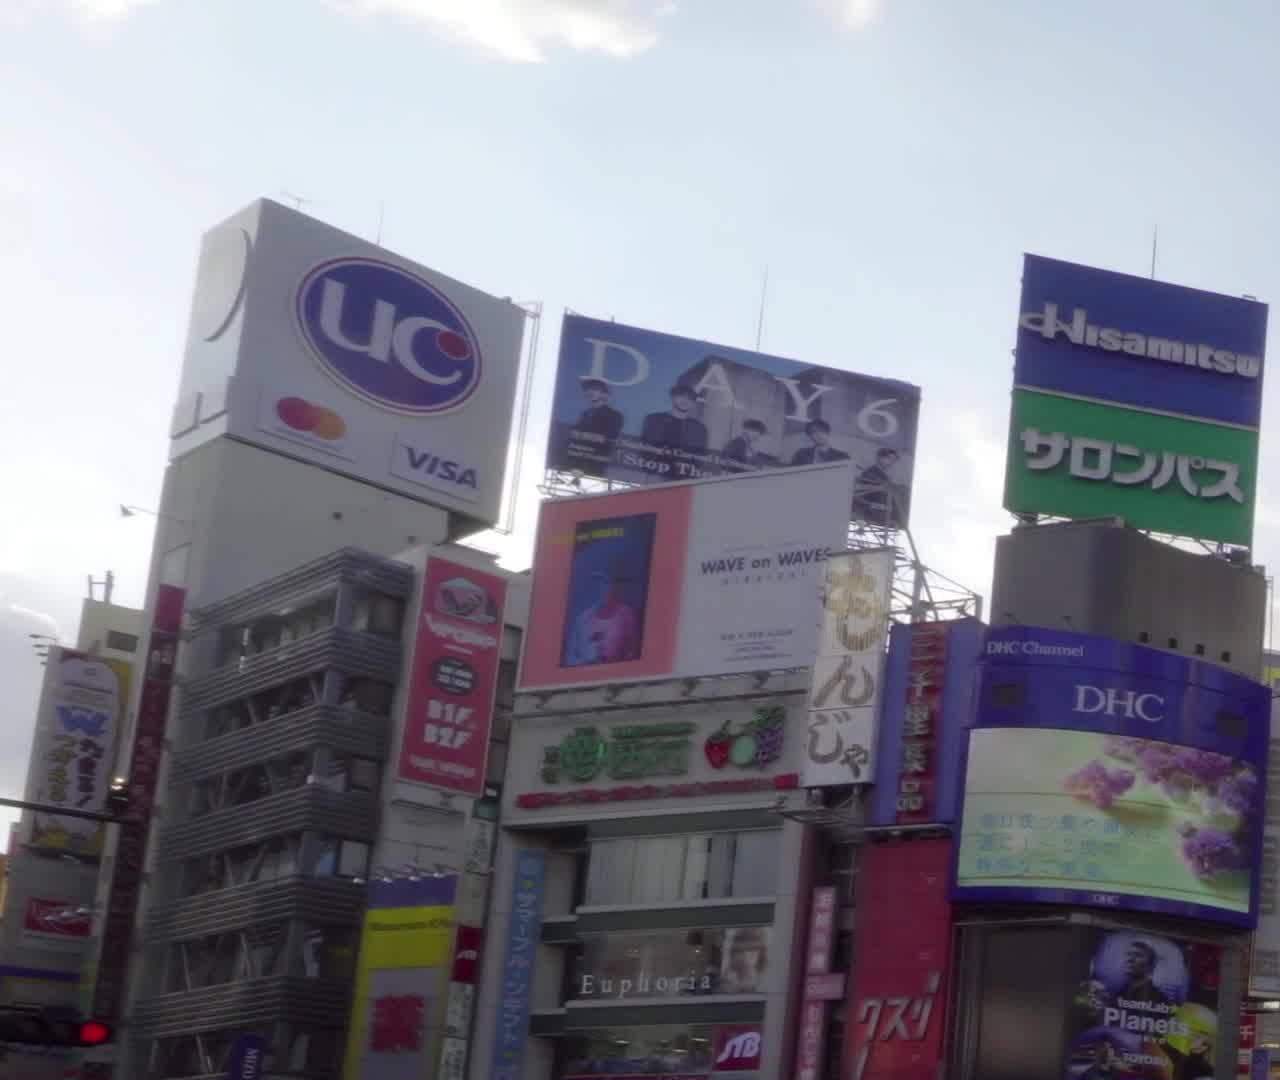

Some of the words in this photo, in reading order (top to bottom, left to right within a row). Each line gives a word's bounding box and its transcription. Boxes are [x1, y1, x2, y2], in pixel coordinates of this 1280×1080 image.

[318, 277, 463, 387] UC
[1018, 302, 1261, 378] Hisamitsu
[403, 444, 479, 490] VISA
[1019, 426, 1246, 505] サロンパス
[701, 557, 746, 577] WAVE
[751, 558, 771, 570] on
[986, 640, 1019, 654] DHC
[1022, 641, 1085, 657] Channel
[1073, 684, 1165, 723] DHC
[1103, 1006, 1191, 1035] Planets
